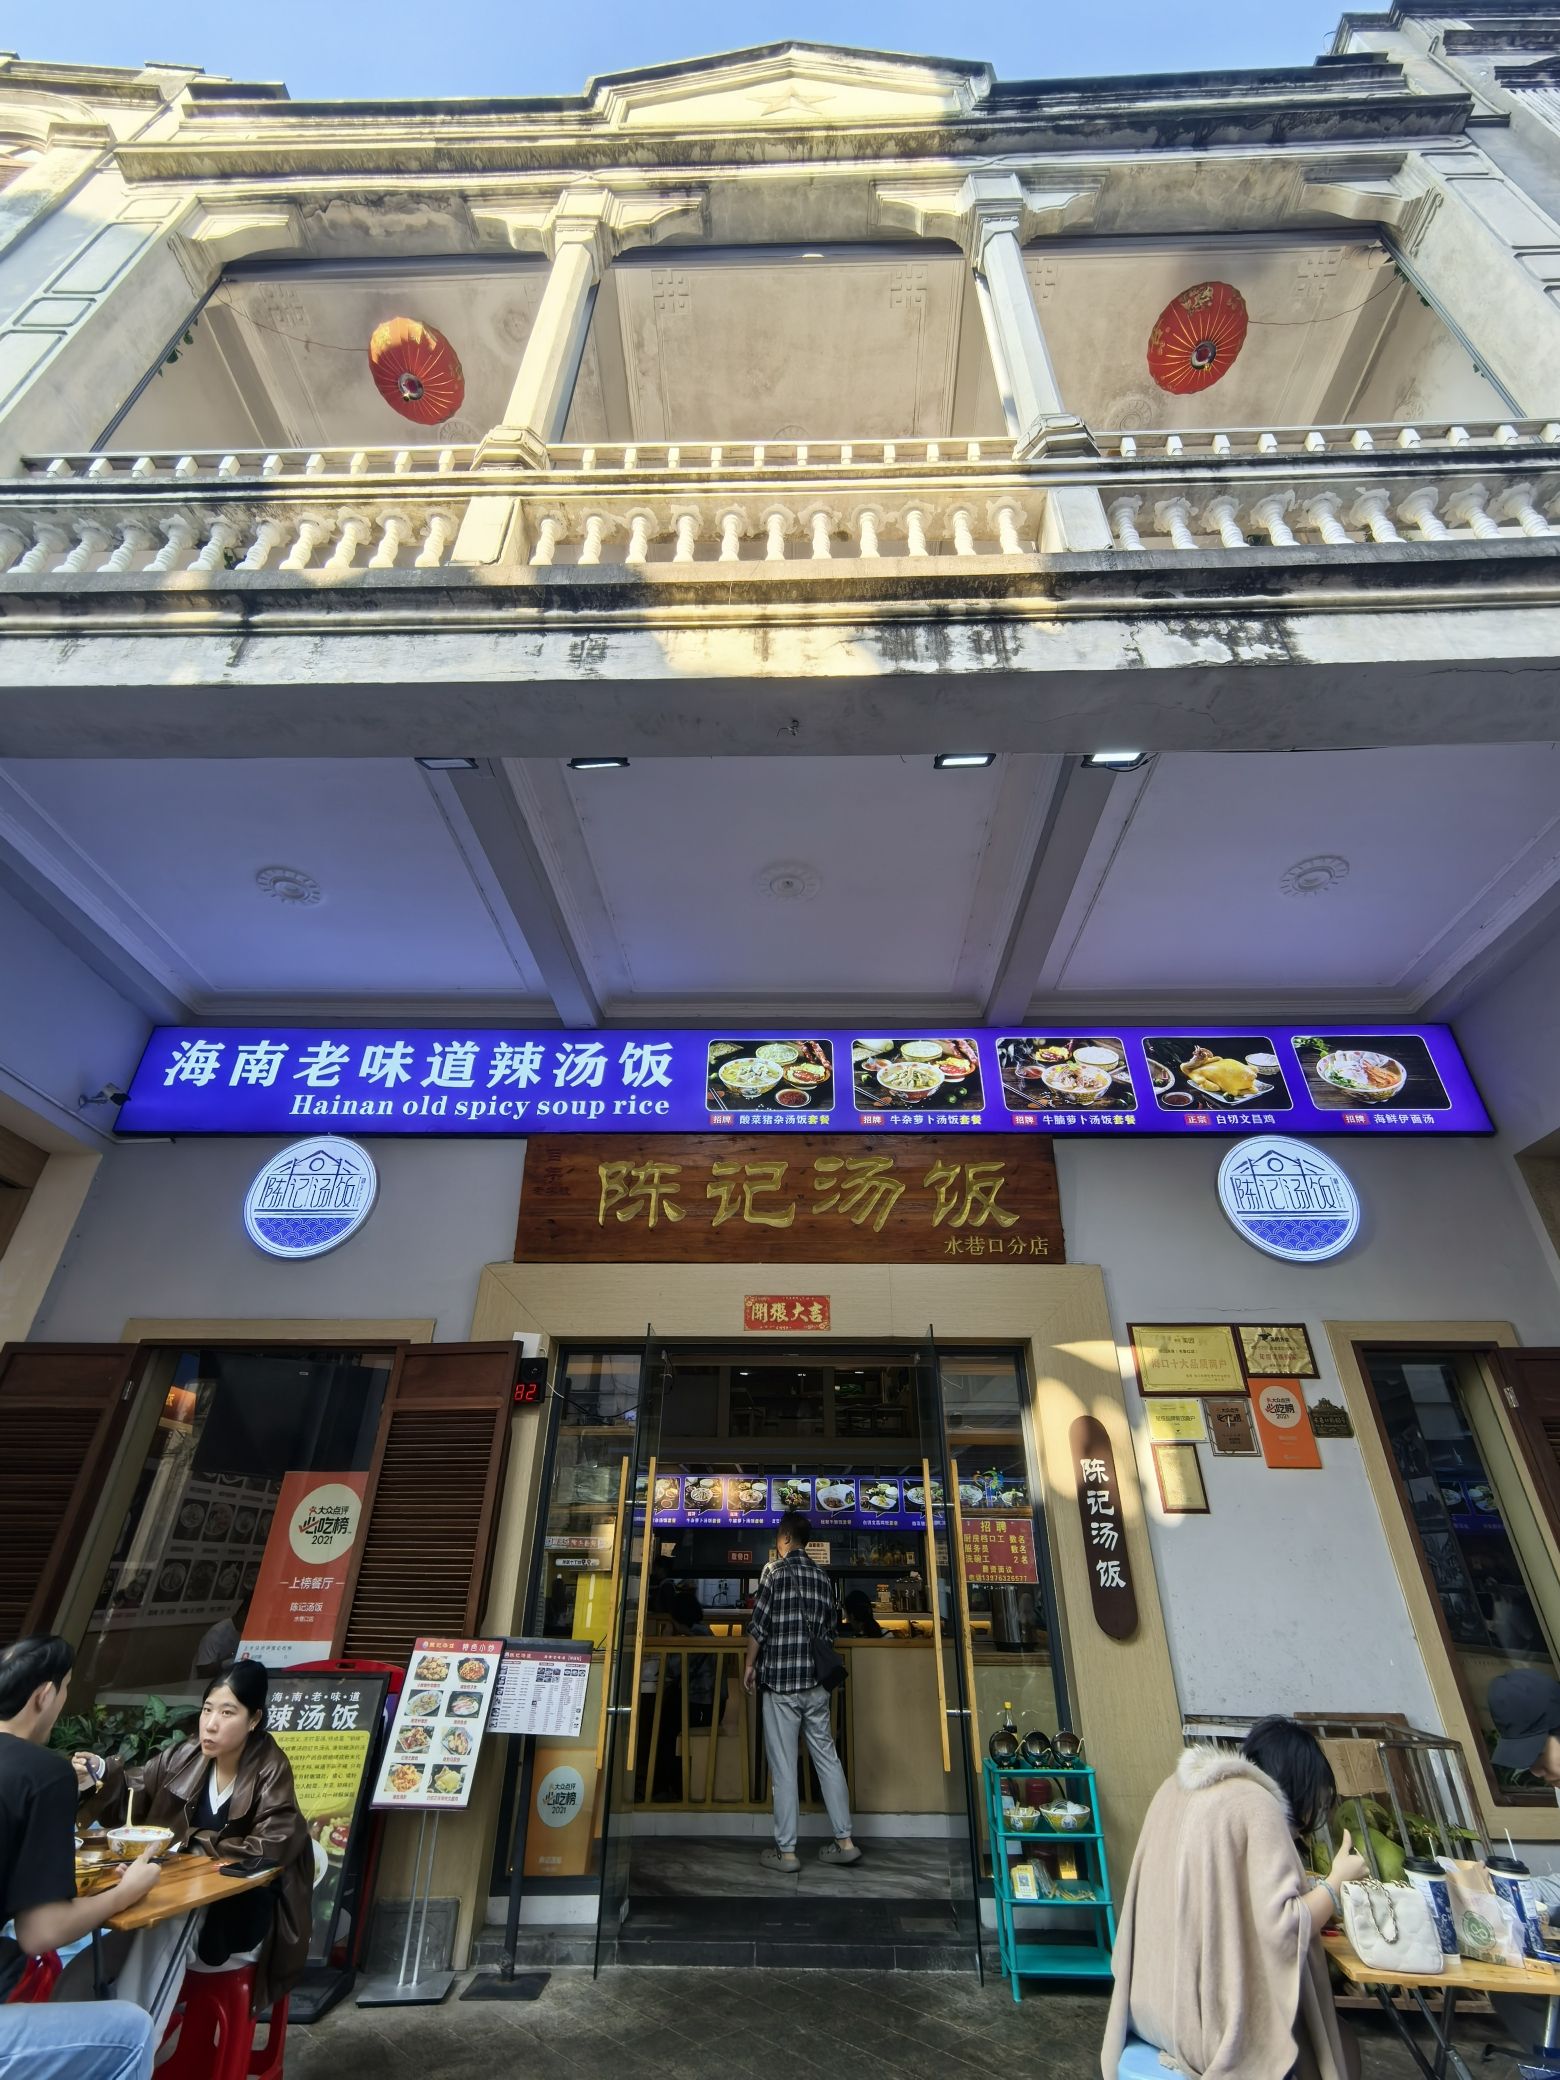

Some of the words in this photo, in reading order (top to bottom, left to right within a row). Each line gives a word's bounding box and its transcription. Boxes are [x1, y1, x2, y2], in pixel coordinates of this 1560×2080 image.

[163, 1040, 673, 1088] 海南老味道辣汤饭
[289, 1095, 393, 1115] Hainan
[402, 1096, 447, 1115] old
[454, 1095, 530, 1120] spicy
[537, 1100, 605, 1119] soup
[612, 1095, 669, 1115] rice
[863, 1115, 882, 1124] 招牌
[890, 1114, 982, 1125] 牛杂萝卜汤饭套餐
[1015, 1115, 1034, 1125] 招牌
[1042, 1114, 1136, 1125] 牛腩萝卜汤饭套餐
[1188, 1115, 1207, 1124] 正宗
[1216, 1114, 1276, 1125] 白切文昌鸡
[1374, 1114, 1435, 1124] 海鲜伊面汤
[259, 1176, 356, 1208] 陈记汤饭
[598, 1156, 1019, 1232] 陈记汤饭
[1234, 1176, 1337, 1209] 陈记汤饭
[944, 1235, 1049, 1256] 水巷口分店
[514, 1384, 537, 1400] 82
[317, 1506, 350, 1515] 大众点评
[298, 1517, 350, 1534] 必吃榜
[980, 1521, 1007, 1533] 招聘
[1080, 1458, 1127, 1588] 陈记汤饭
[311, 1536, 333, 1545] 2021
[288, 1577, 334, 1590] 上榜餐厅
[266, 1704, 360, 1731] 辣汤饭
[551, 1806, 566, 1814] 2021
